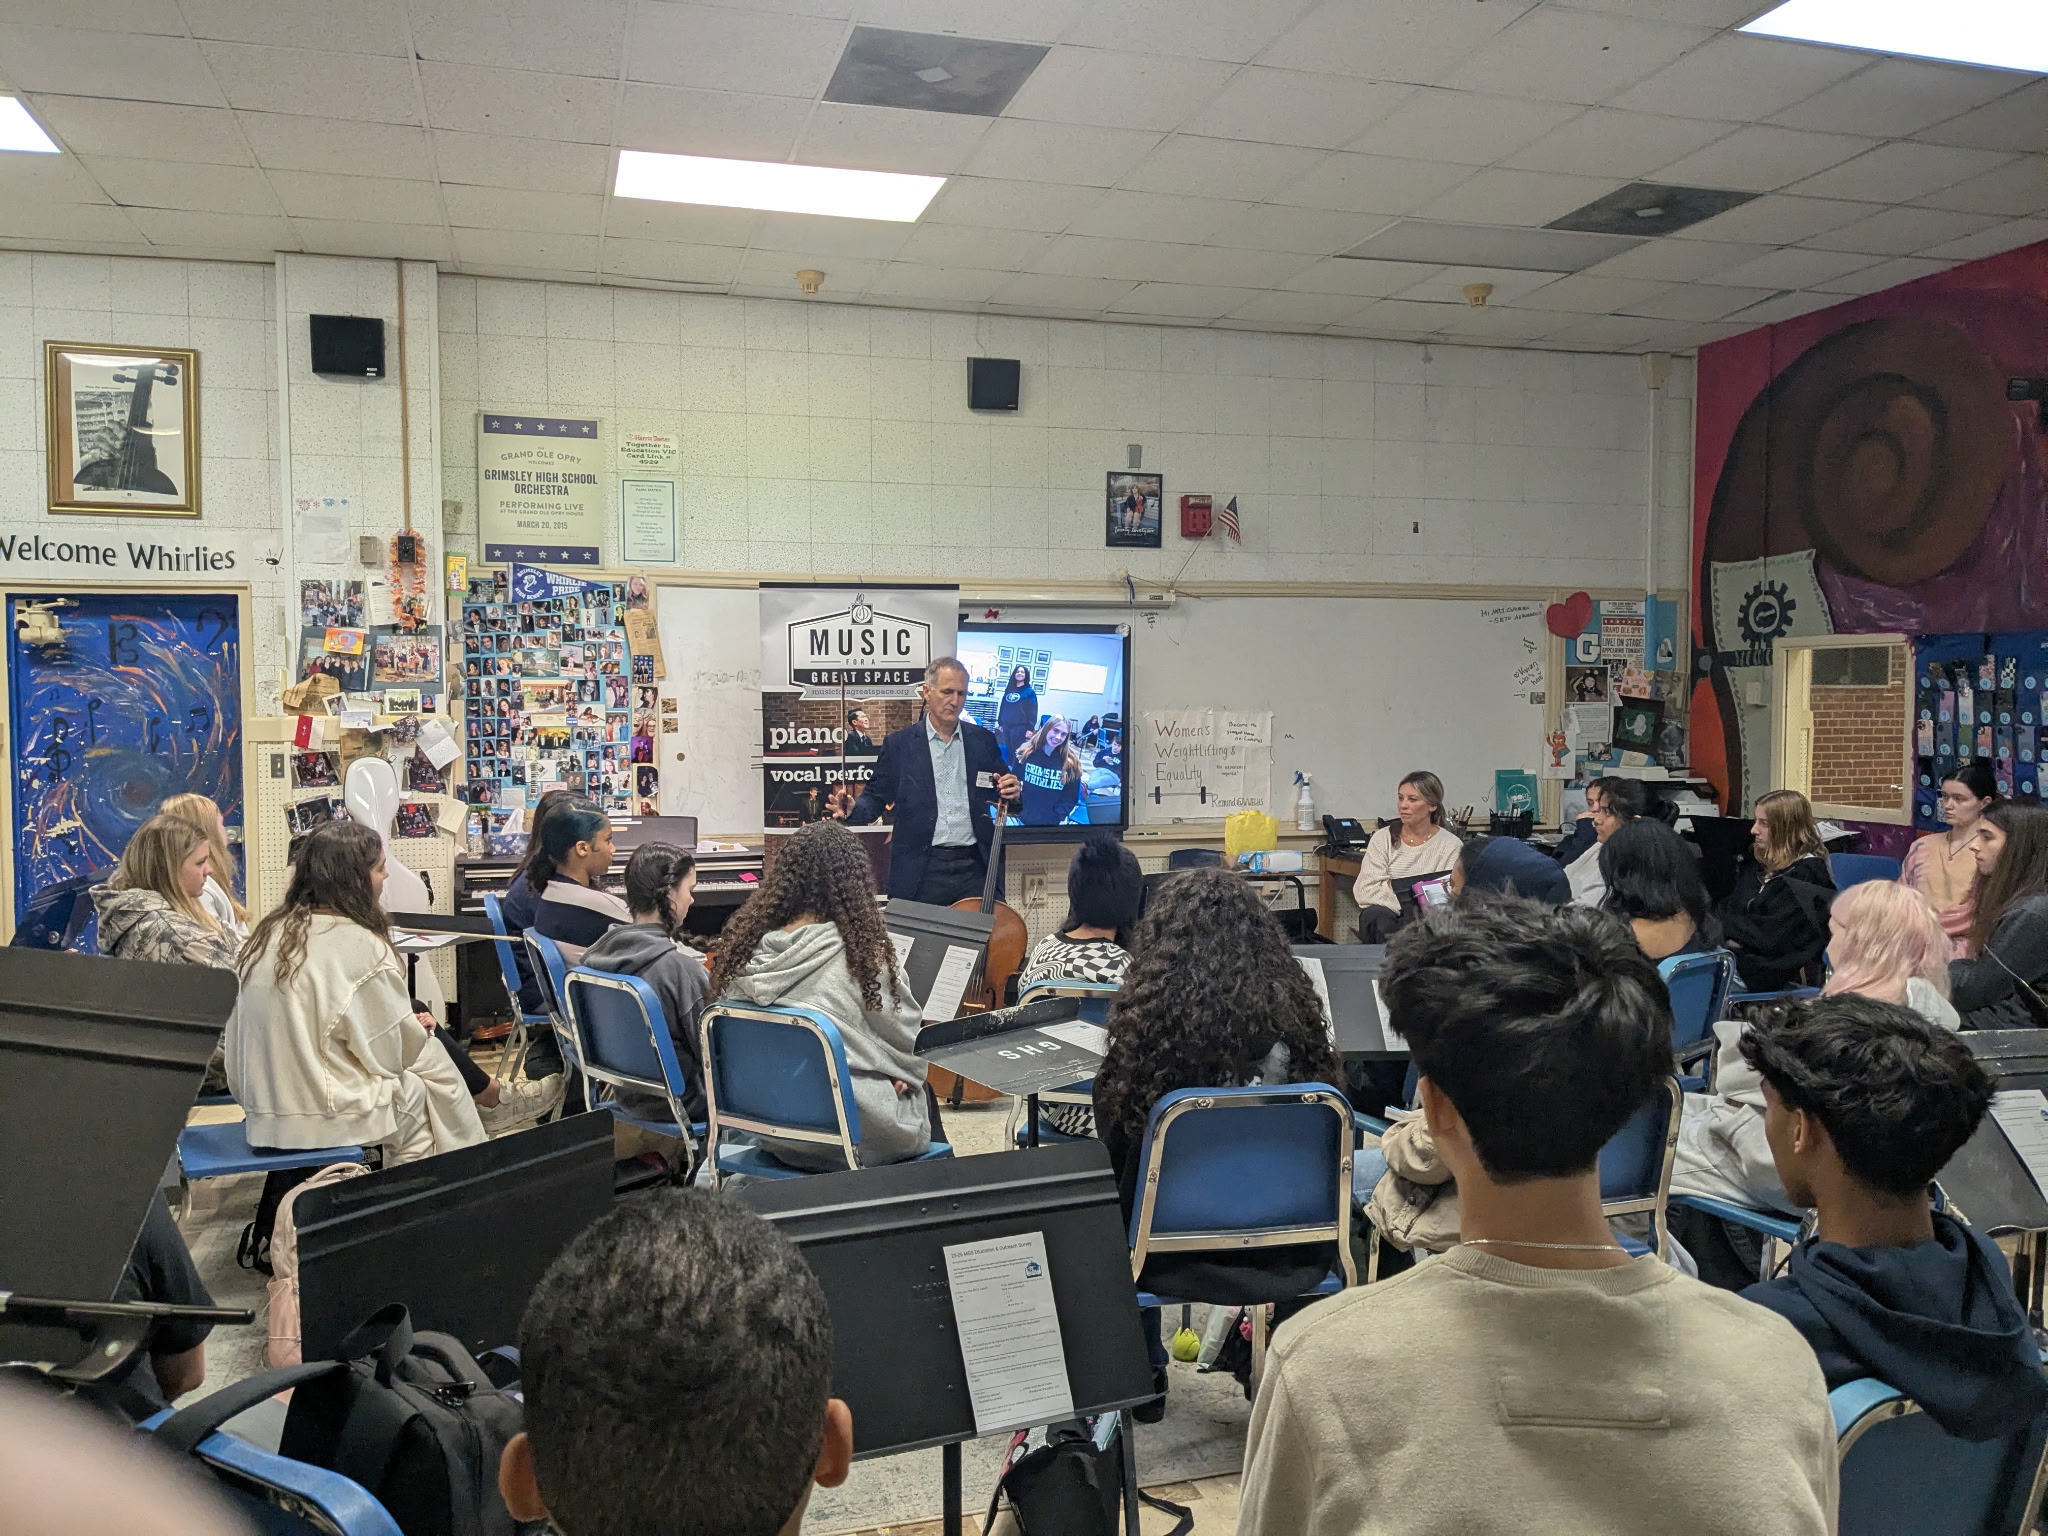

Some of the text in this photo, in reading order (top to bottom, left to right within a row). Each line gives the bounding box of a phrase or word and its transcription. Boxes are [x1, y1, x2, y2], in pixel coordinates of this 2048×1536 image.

[500, 450, 582, 464] GRAND OLE OPRY
[484, 468, 598, 485] GRIMSLEY HIGH SCHOOL
[514, 483, 569, 496] ORCHESTRA
[500, 500, 584, 511] PERFORMING LIVE
[516, 520, 568, 530] MARCH 20, 2015
[0, 534, 236, 572] Welcome Whirlies
[516, 568, 544, 578] GRIMSLEY
[545, 572, 588, 587] WHIRLIE
[514, 587, 545, 600] HIGH SCHOOL
[551, 586, 581, 596] PRIDE
[810, 629, 911, 656] MUSIC
[1575, 632, 1601, 664] G
[1617, 637, 1625, 647] ON
[845, 658, 876, 666] FOR A
[811, 671, 910, 684] GREAT SPACE
[769, 721, 848, 750] piano
[1155, 720, 1211, 738] Women's
[770, 766, 822, 783] vocal
[974, 1247, 995, 1255] Education
[999, 1243, 1018, 1251] Outreach
[1018, 1241, 1032, 1249] Survey
